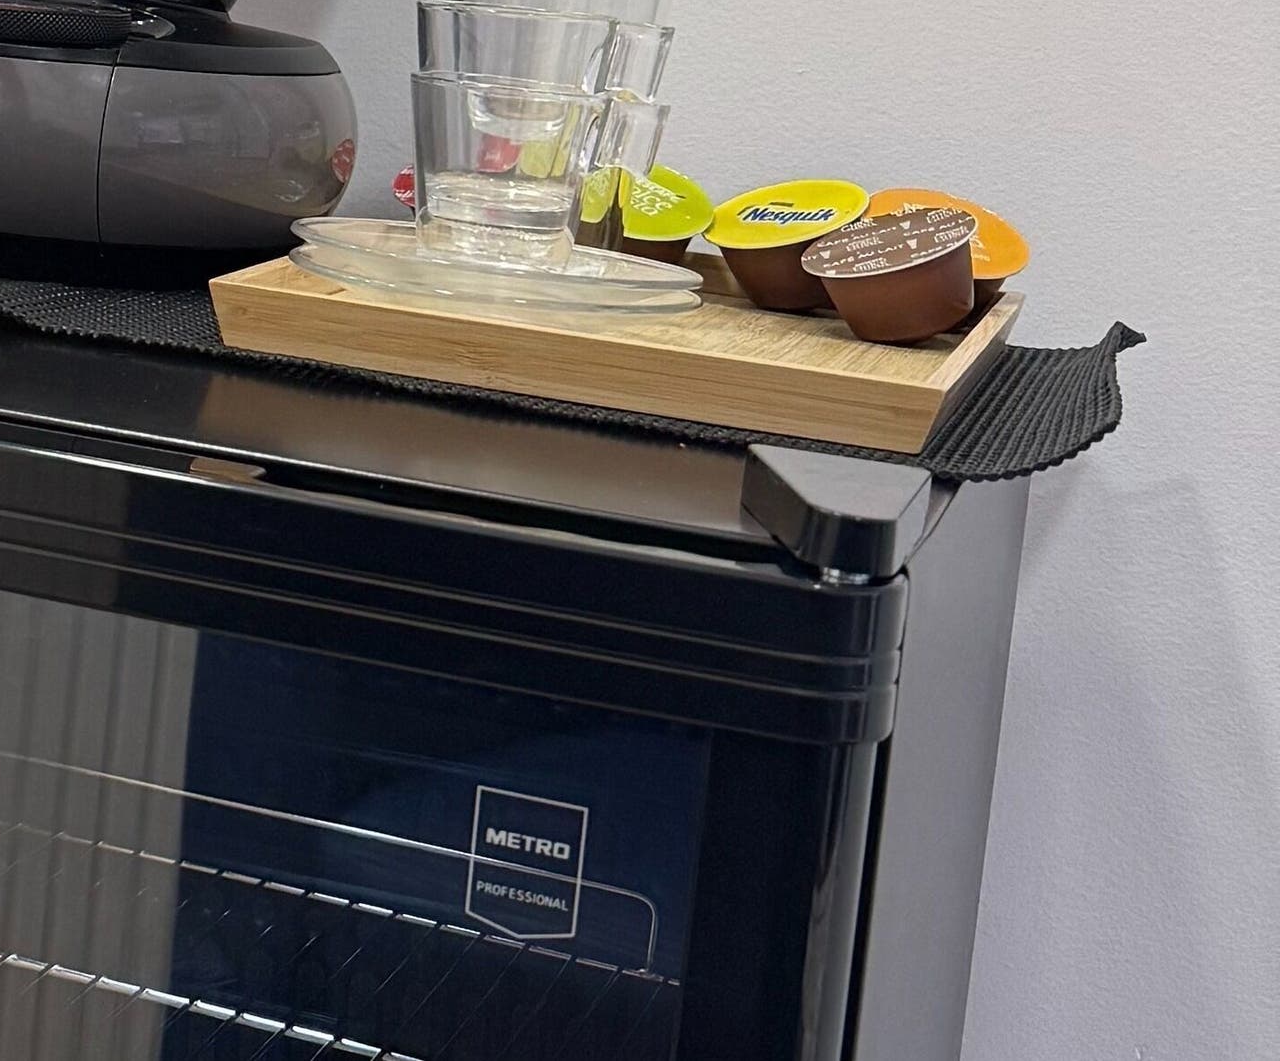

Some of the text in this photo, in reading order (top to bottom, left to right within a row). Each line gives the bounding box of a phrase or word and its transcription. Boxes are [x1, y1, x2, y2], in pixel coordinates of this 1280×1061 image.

[741, 206, 836, 226] Nesquik
[485, 827, 571, 860] METRO
[476, 880, 569, 912] PROFESSIONAL
